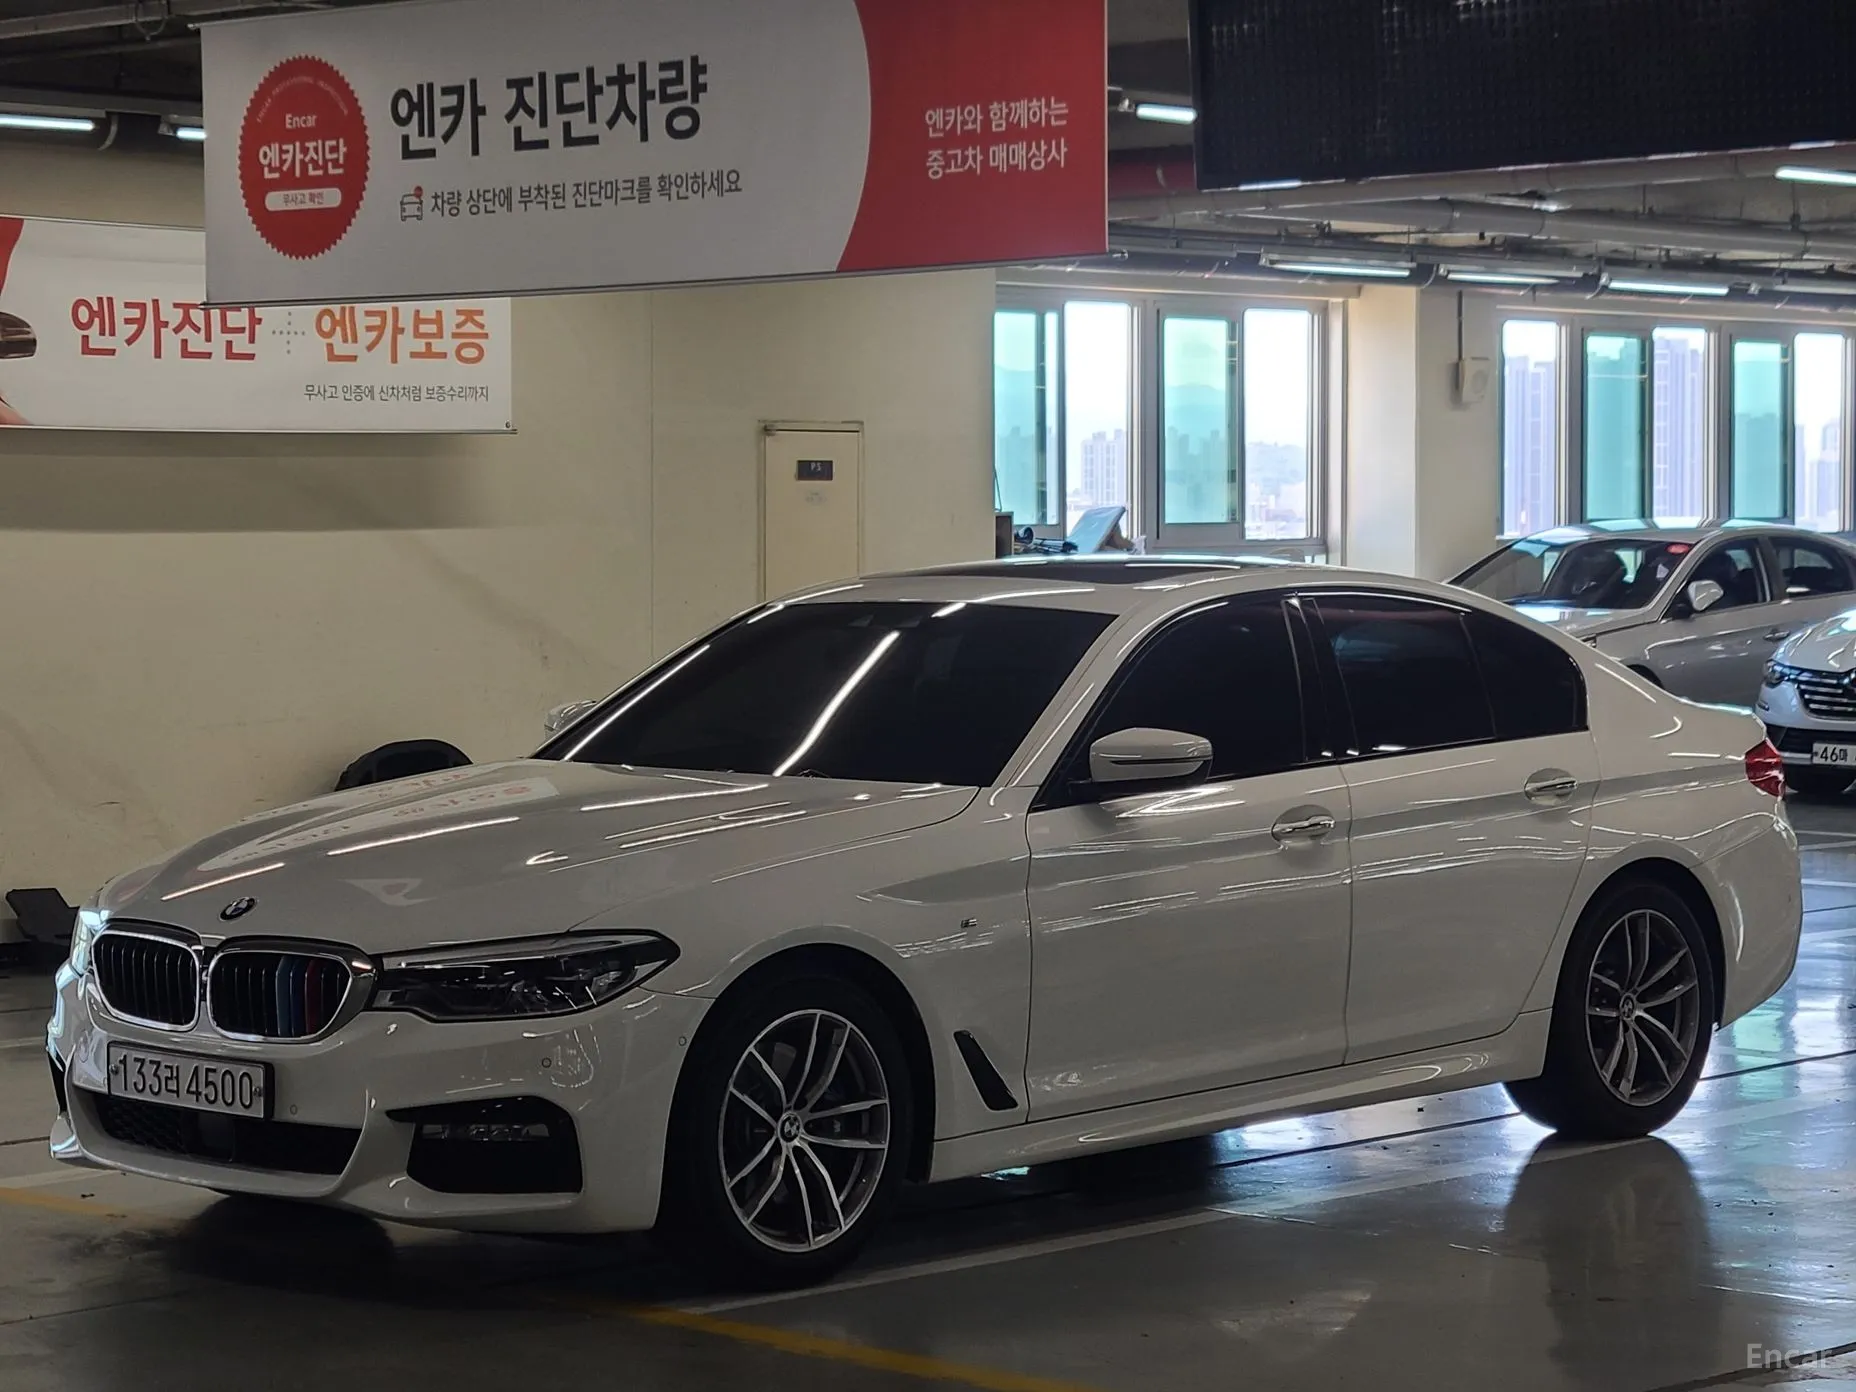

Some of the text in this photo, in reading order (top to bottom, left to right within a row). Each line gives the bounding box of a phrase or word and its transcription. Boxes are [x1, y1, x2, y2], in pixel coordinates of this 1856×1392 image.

[285, 113, 317, 130] Encar
[391, 77, 487, 160] 엔카
[504, 54, 708, 152] 진단차량
[925, 97, 1068, 138] 엔카와 함께하는
[258, 138, 347, 179] 엔카진단
[926, 138, 1068, 180] 중고차 매매상사
[431, 168, 742, 217] 차량 상단에 부착된 진단마크를 확인하세요
[71, 296, 489, 365] 엔카진단 엔카보증
[304, 384, 489, 402] 무사고 인증에 신차처럼 보증수리까지
[119, 1054, 253, 1110] 133러 4500
